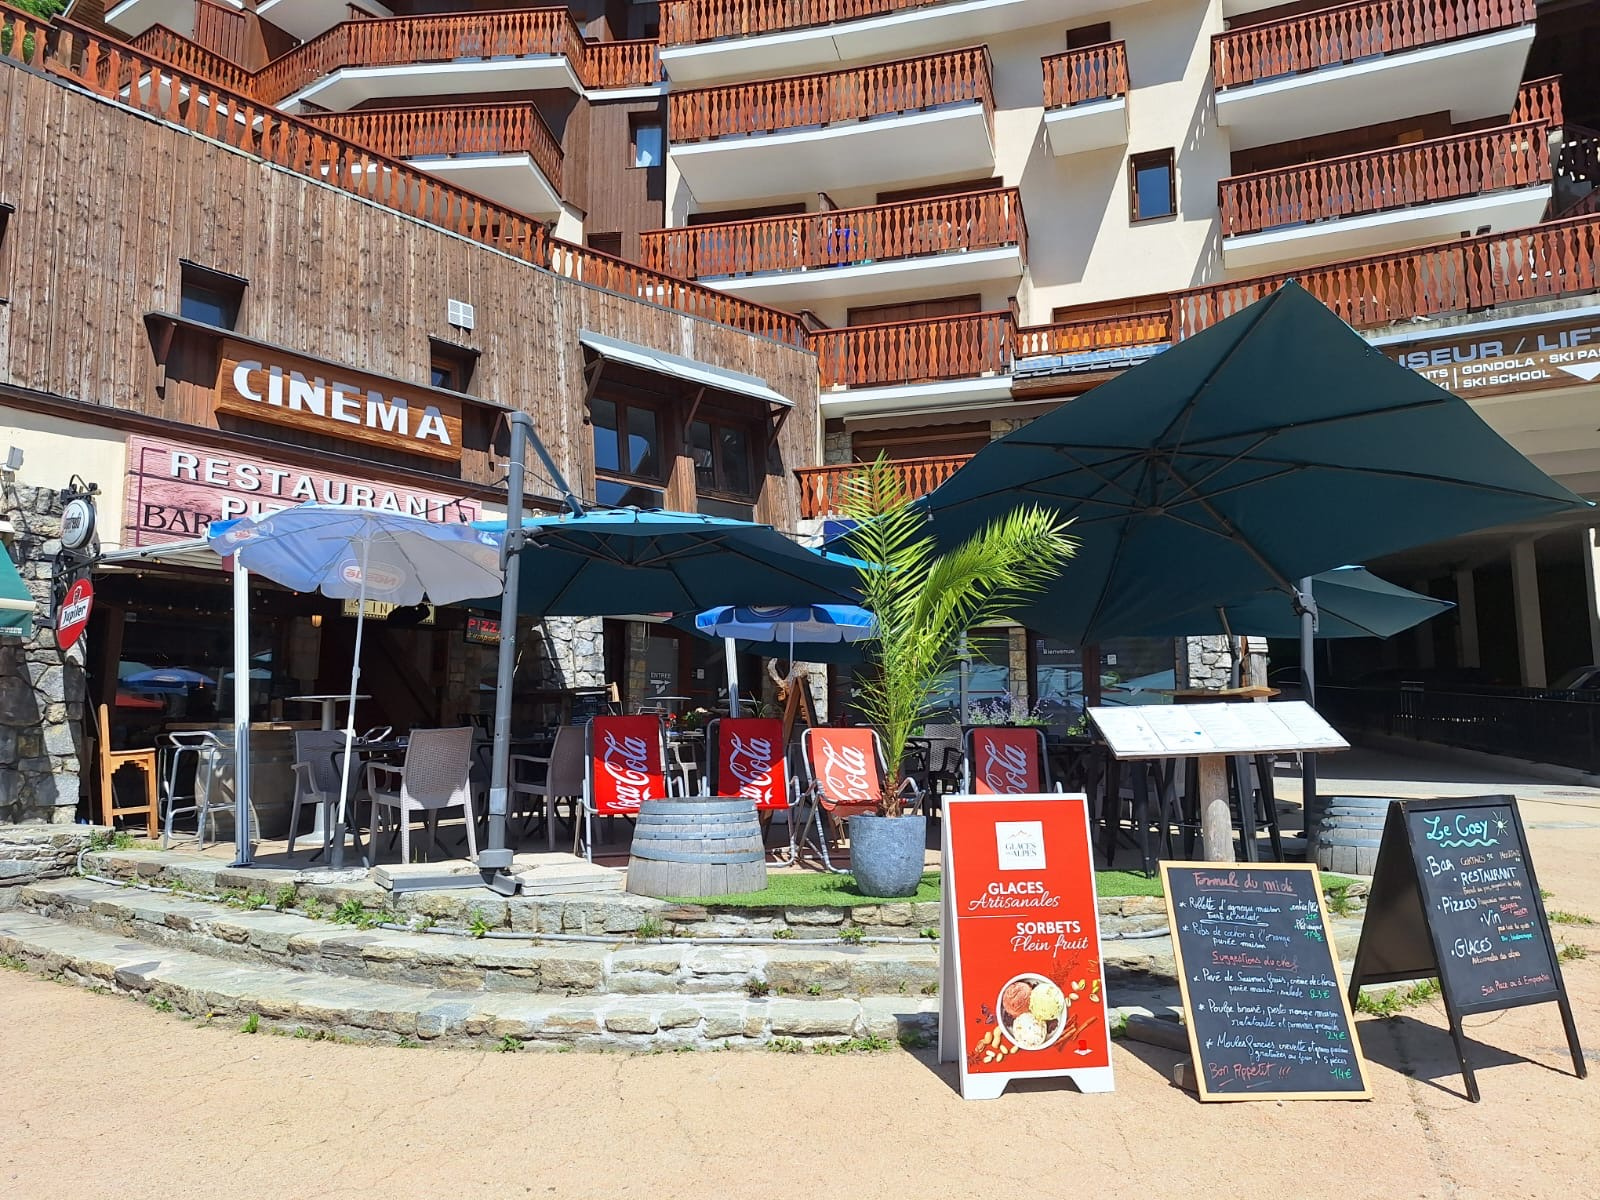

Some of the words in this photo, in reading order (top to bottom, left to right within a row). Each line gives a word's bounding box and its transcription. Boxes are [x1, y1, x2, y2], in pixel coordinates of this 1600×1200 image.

[1462, 357, 1536, 375] GONDOLA
[1549, 349, 1574, 364] SKI
[1578, 346, 1600, 360] PA
[1463, 376, 1486, 389] SKI
[1489, 369, 1551, 386] SCHOOL
[232, 359, 452, 446] CINEMA
[168, 450, 454, 523] RESTAURANT
[62, 604, 87, 624] Jupiler
[467, 617, 501, 634] PIZZ
[1424, 815, 1452, 840] Le
[1455, 814, 1488, 840] Cosy
[1193, 872, 1239, 888] Formule
[1243, 873, 1258, 889] du
[1460, 867, 1517, 887] RESTAURANT
[988, 881, 1044, 895] GLACES
[968, 891, 1061, 911] Artisanales
[1441, 896, 1478, 915] Pizzas
[1016, 920, 1081, 935] SORBETS
[1482, 909, 1502, 926] Vin
[1010, 935, 1051, 952] Plein
[1052, 934, 1089, 958] fruit
